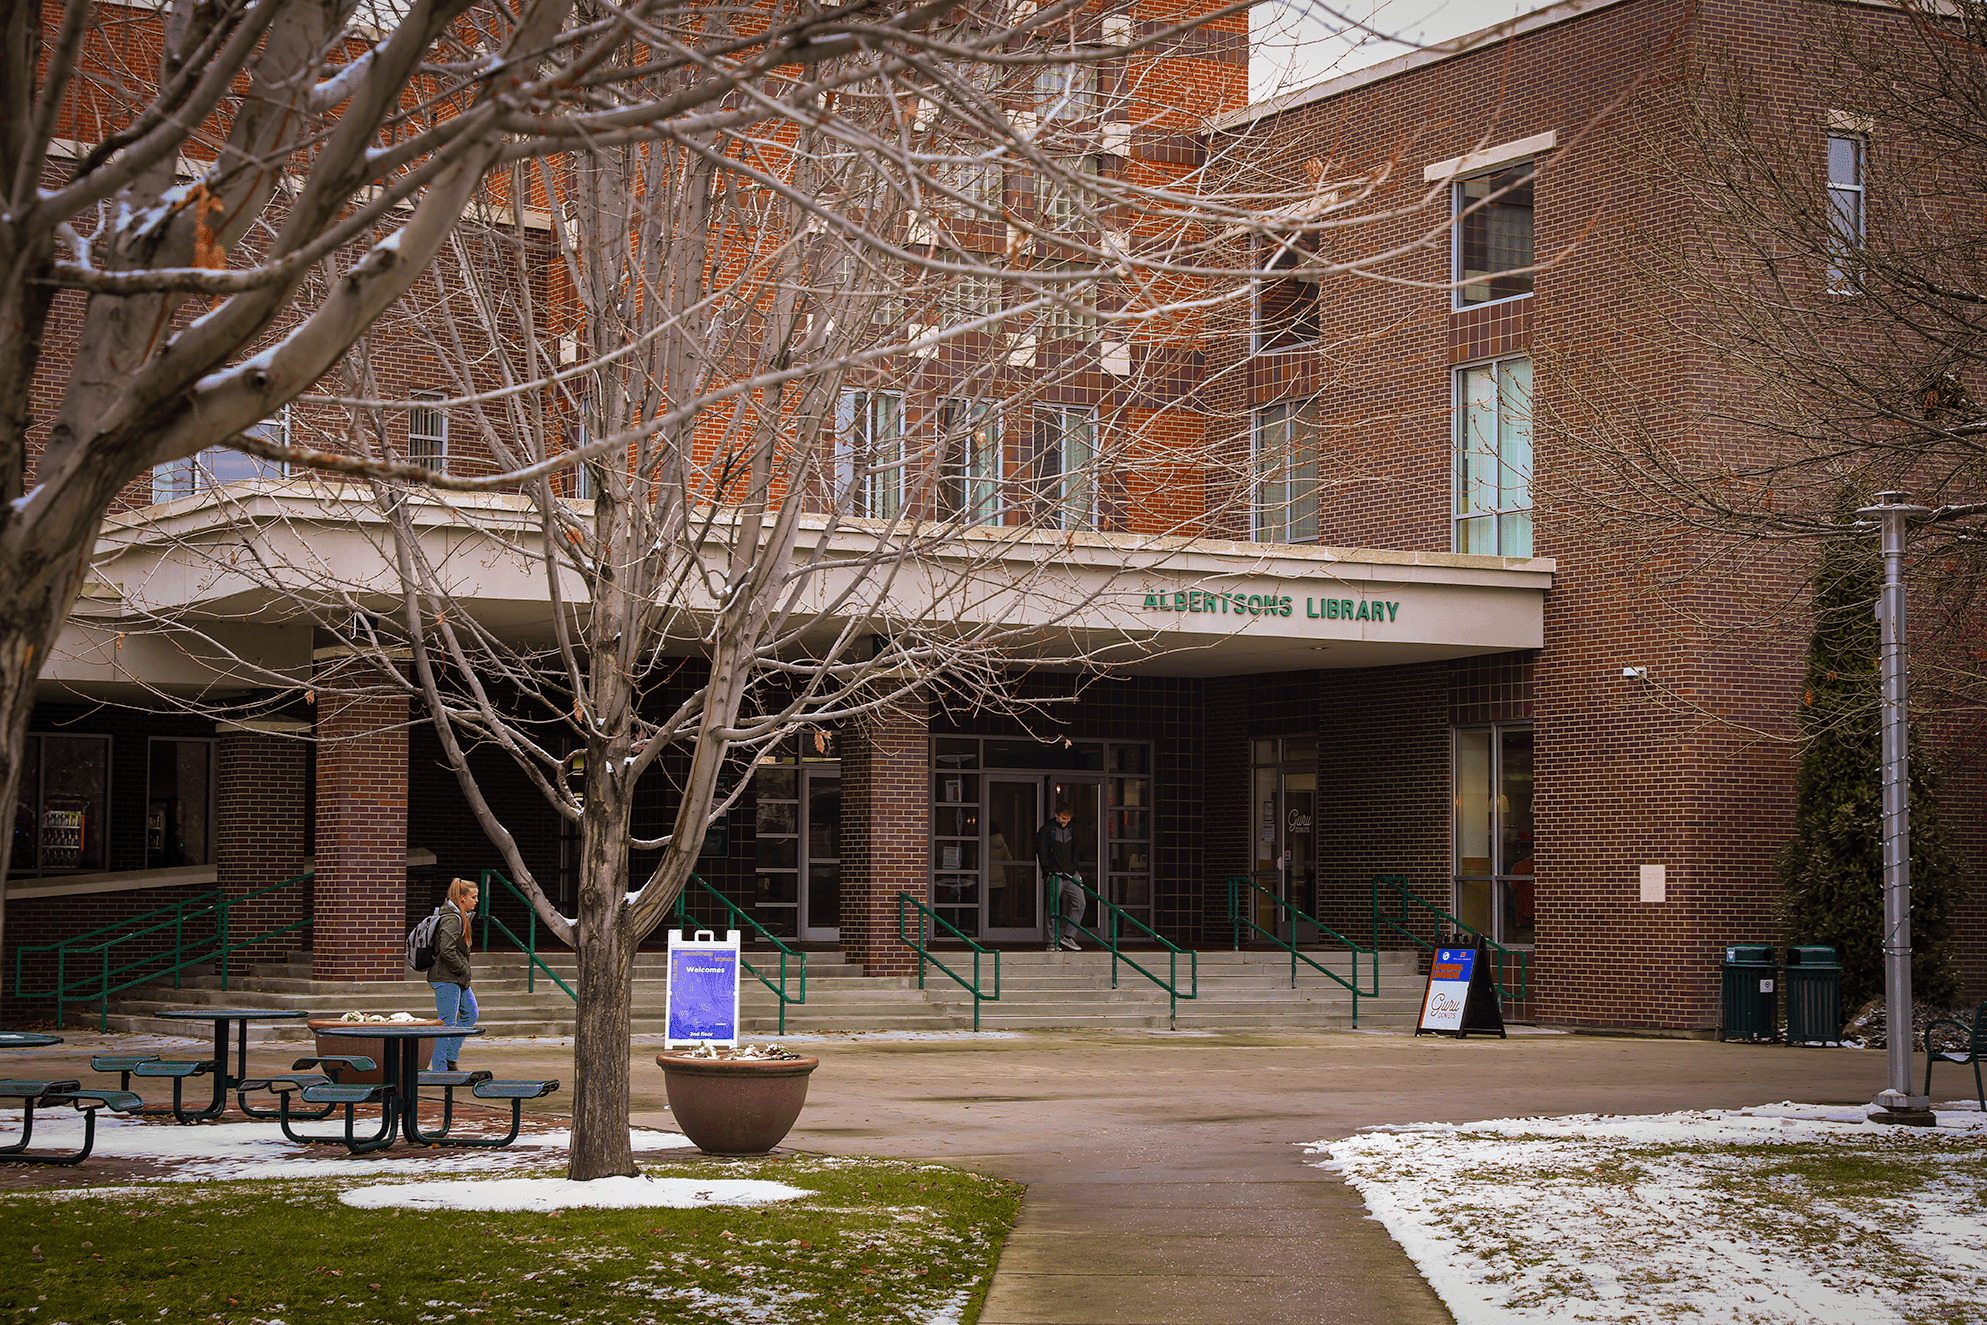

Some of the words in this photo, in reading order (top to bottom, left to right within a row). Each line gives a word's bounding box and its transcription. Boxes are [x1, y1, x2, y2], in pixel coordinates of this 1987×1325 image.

[1143, 589, 1293, 617] ALBERTSONS
[1307, 597, 1400, 622] LIBRARY
[1288, 809, 1312, 832] Guru
[1430, 993, 1460, 1016] Guru
